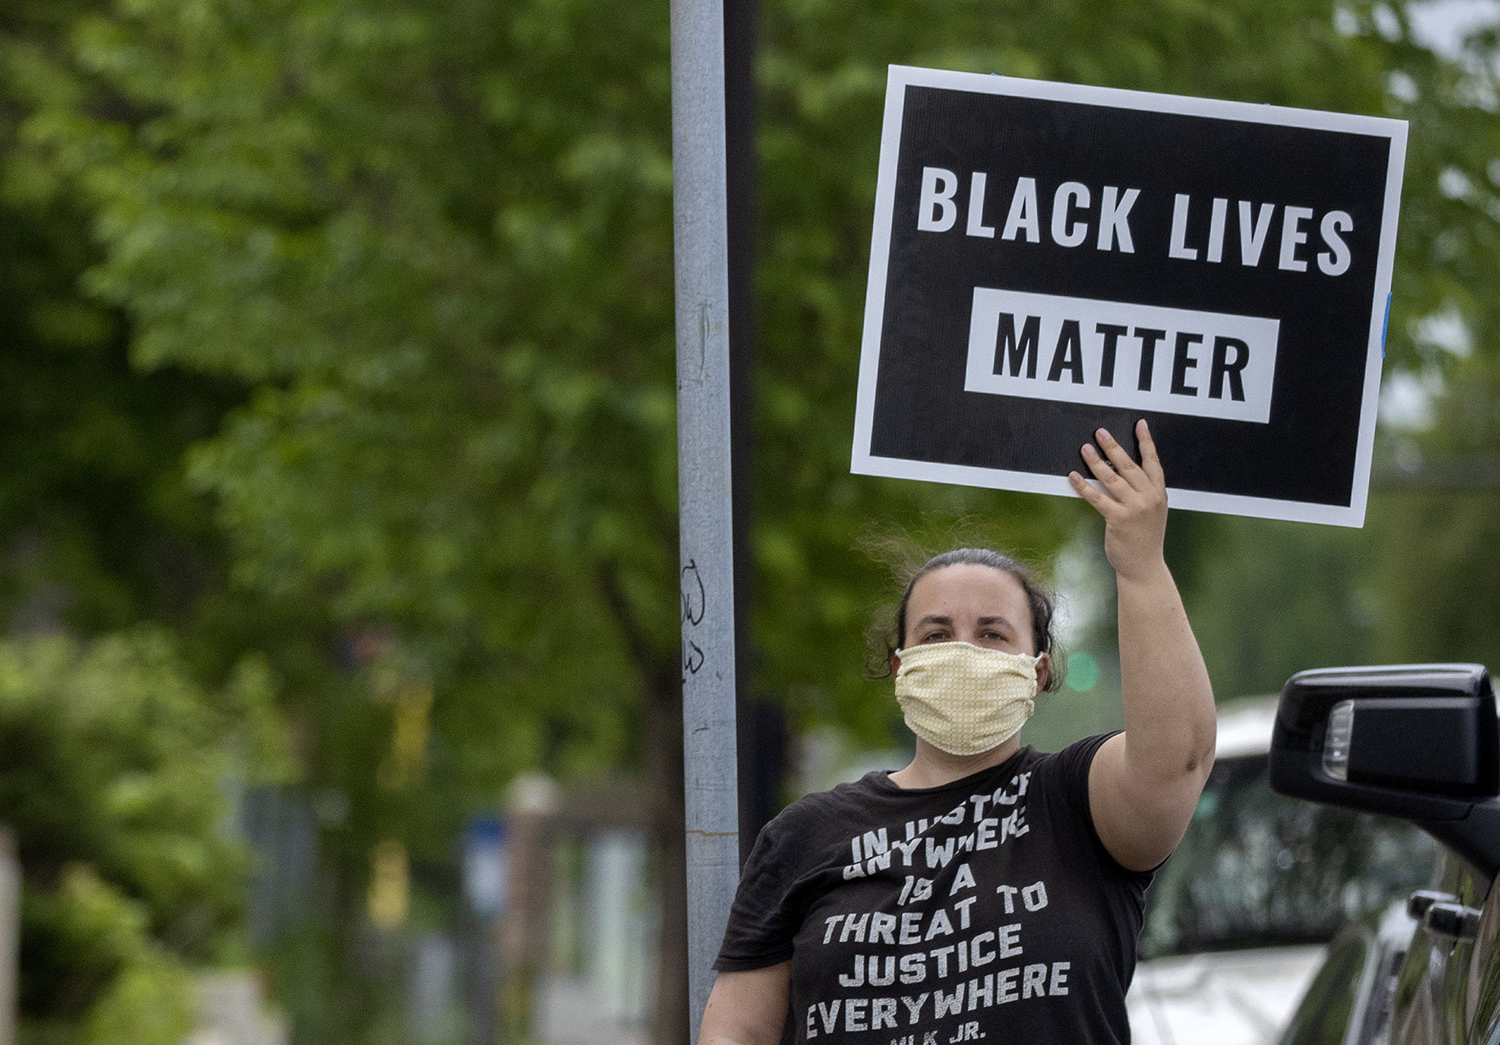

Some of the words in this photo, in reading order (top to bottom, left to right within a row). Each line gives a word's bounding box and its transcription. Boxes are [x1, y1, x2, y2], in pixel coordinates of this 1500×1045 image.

[917, 166, 1141, 253] BLACK
[1168, 193, 1354, 277] LIVES
[991, 312, 1251, 402] MATTER
[823, 896, 977, 945] THREAT
[997, 881, 1049, 914] TO
[897, 875, 934, 906] IS
[949, 863, 976, 896] A
[838, 923, 1024, 987] JUSTICE
[806, 961, 1071, 1039] EVERYWHERE
[949, 1020, 986, 1043] JR.
